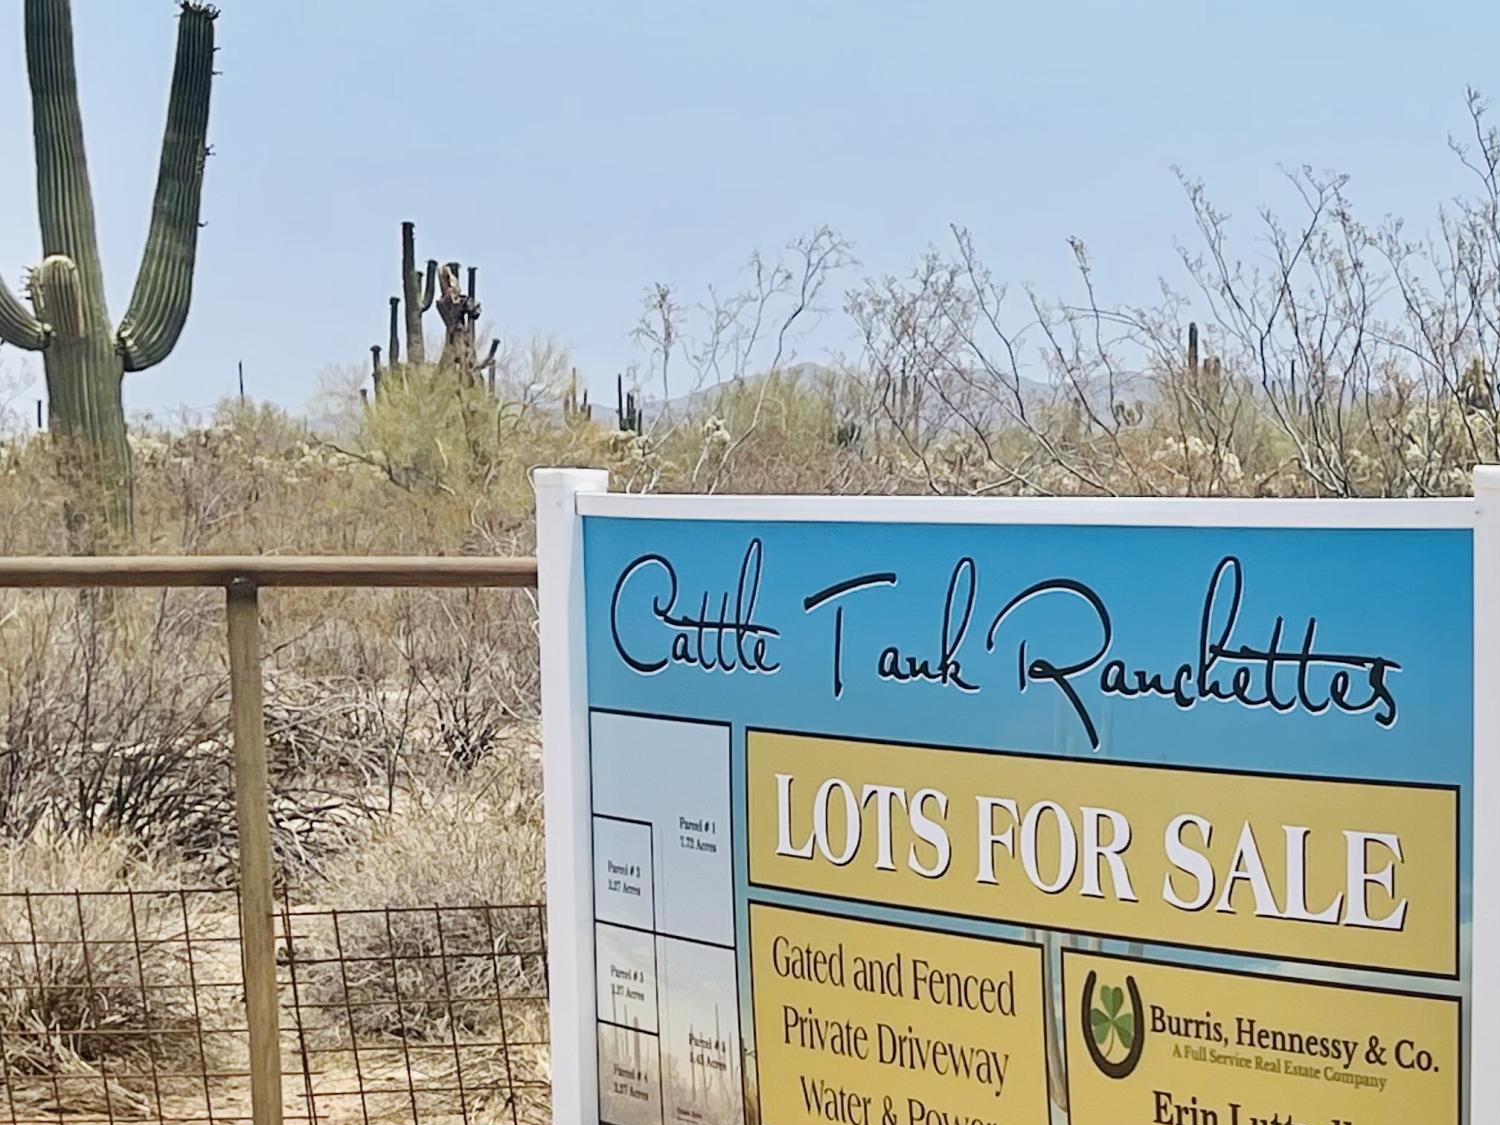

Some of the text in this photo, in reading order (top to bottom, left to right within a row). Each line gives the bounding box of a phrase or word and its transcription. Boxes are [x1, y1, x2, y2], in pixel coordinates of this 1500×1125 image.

[610, 537, 1402, 751] Cattle Tank Ranchettes
[774, 773, 1409, 932] LOTS FOR SALE
[772, 935, 1017, 1018] Gated and Fenced
[783, 1004, 1010, 1098] Private Driveway
[1150, 1004, 1440, 1073] Burris, Hennessy & Co.
[1172, 1044, 1388, 1092] A Full Service Real Estate Company
